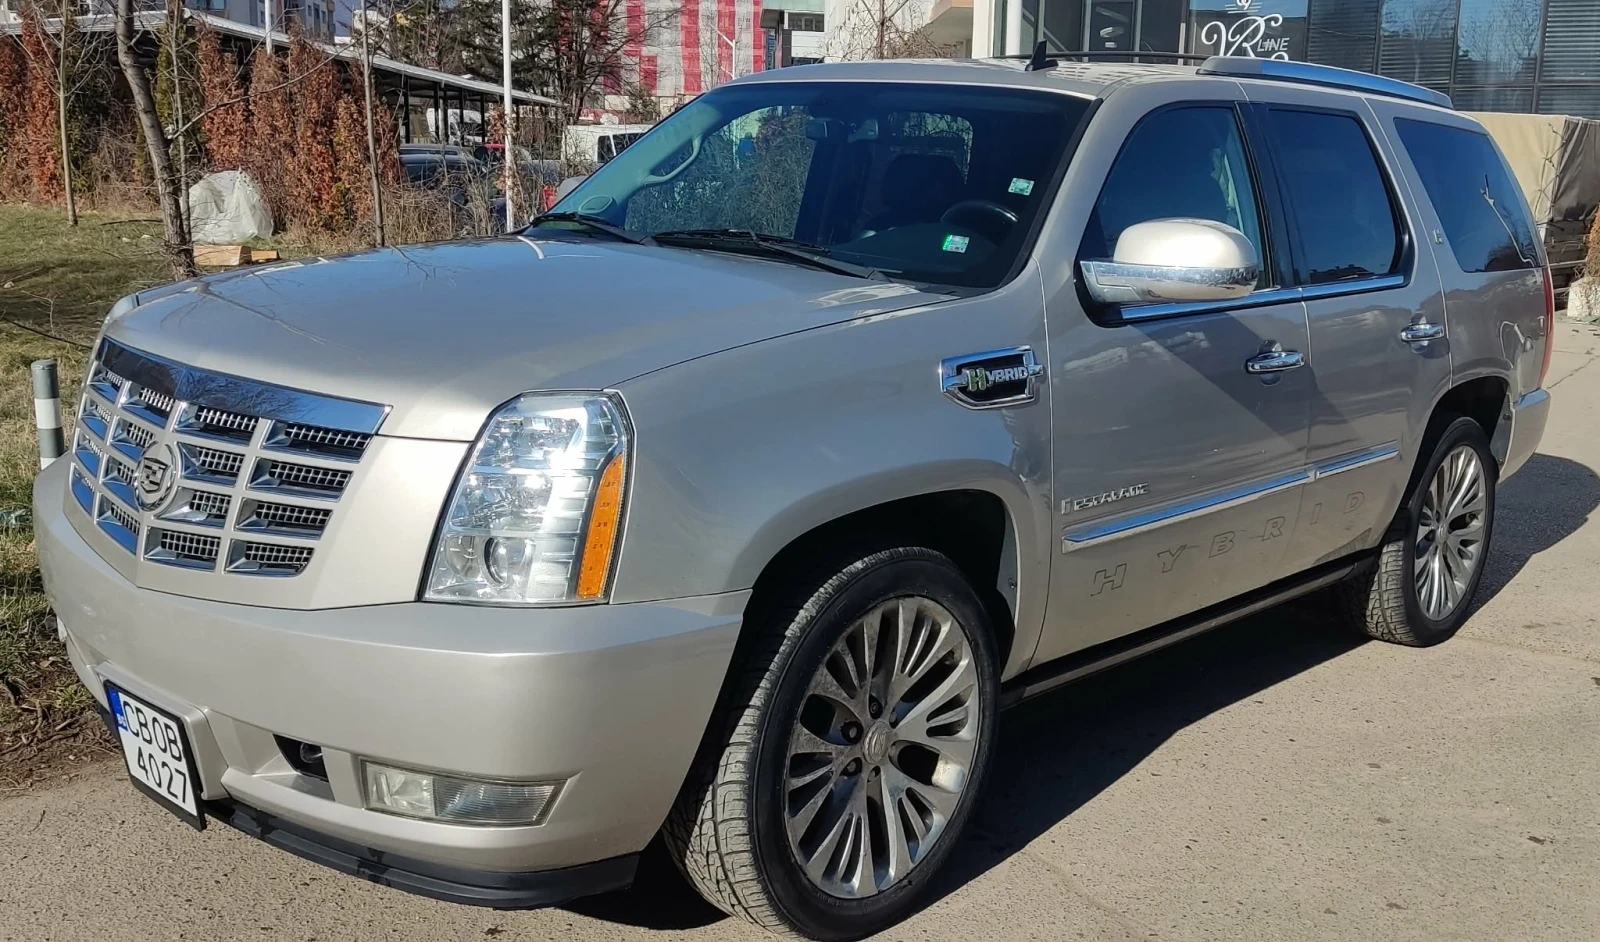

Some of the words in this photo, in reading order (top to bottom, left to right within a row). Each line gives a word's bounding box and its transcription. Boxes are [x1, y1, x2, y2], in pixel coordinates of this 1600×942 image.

[967, 366, 1029, 392] HYBRID
[1074, 482, 1149, 511] ESCALADE
[137, 746, 187, 804] 4027
